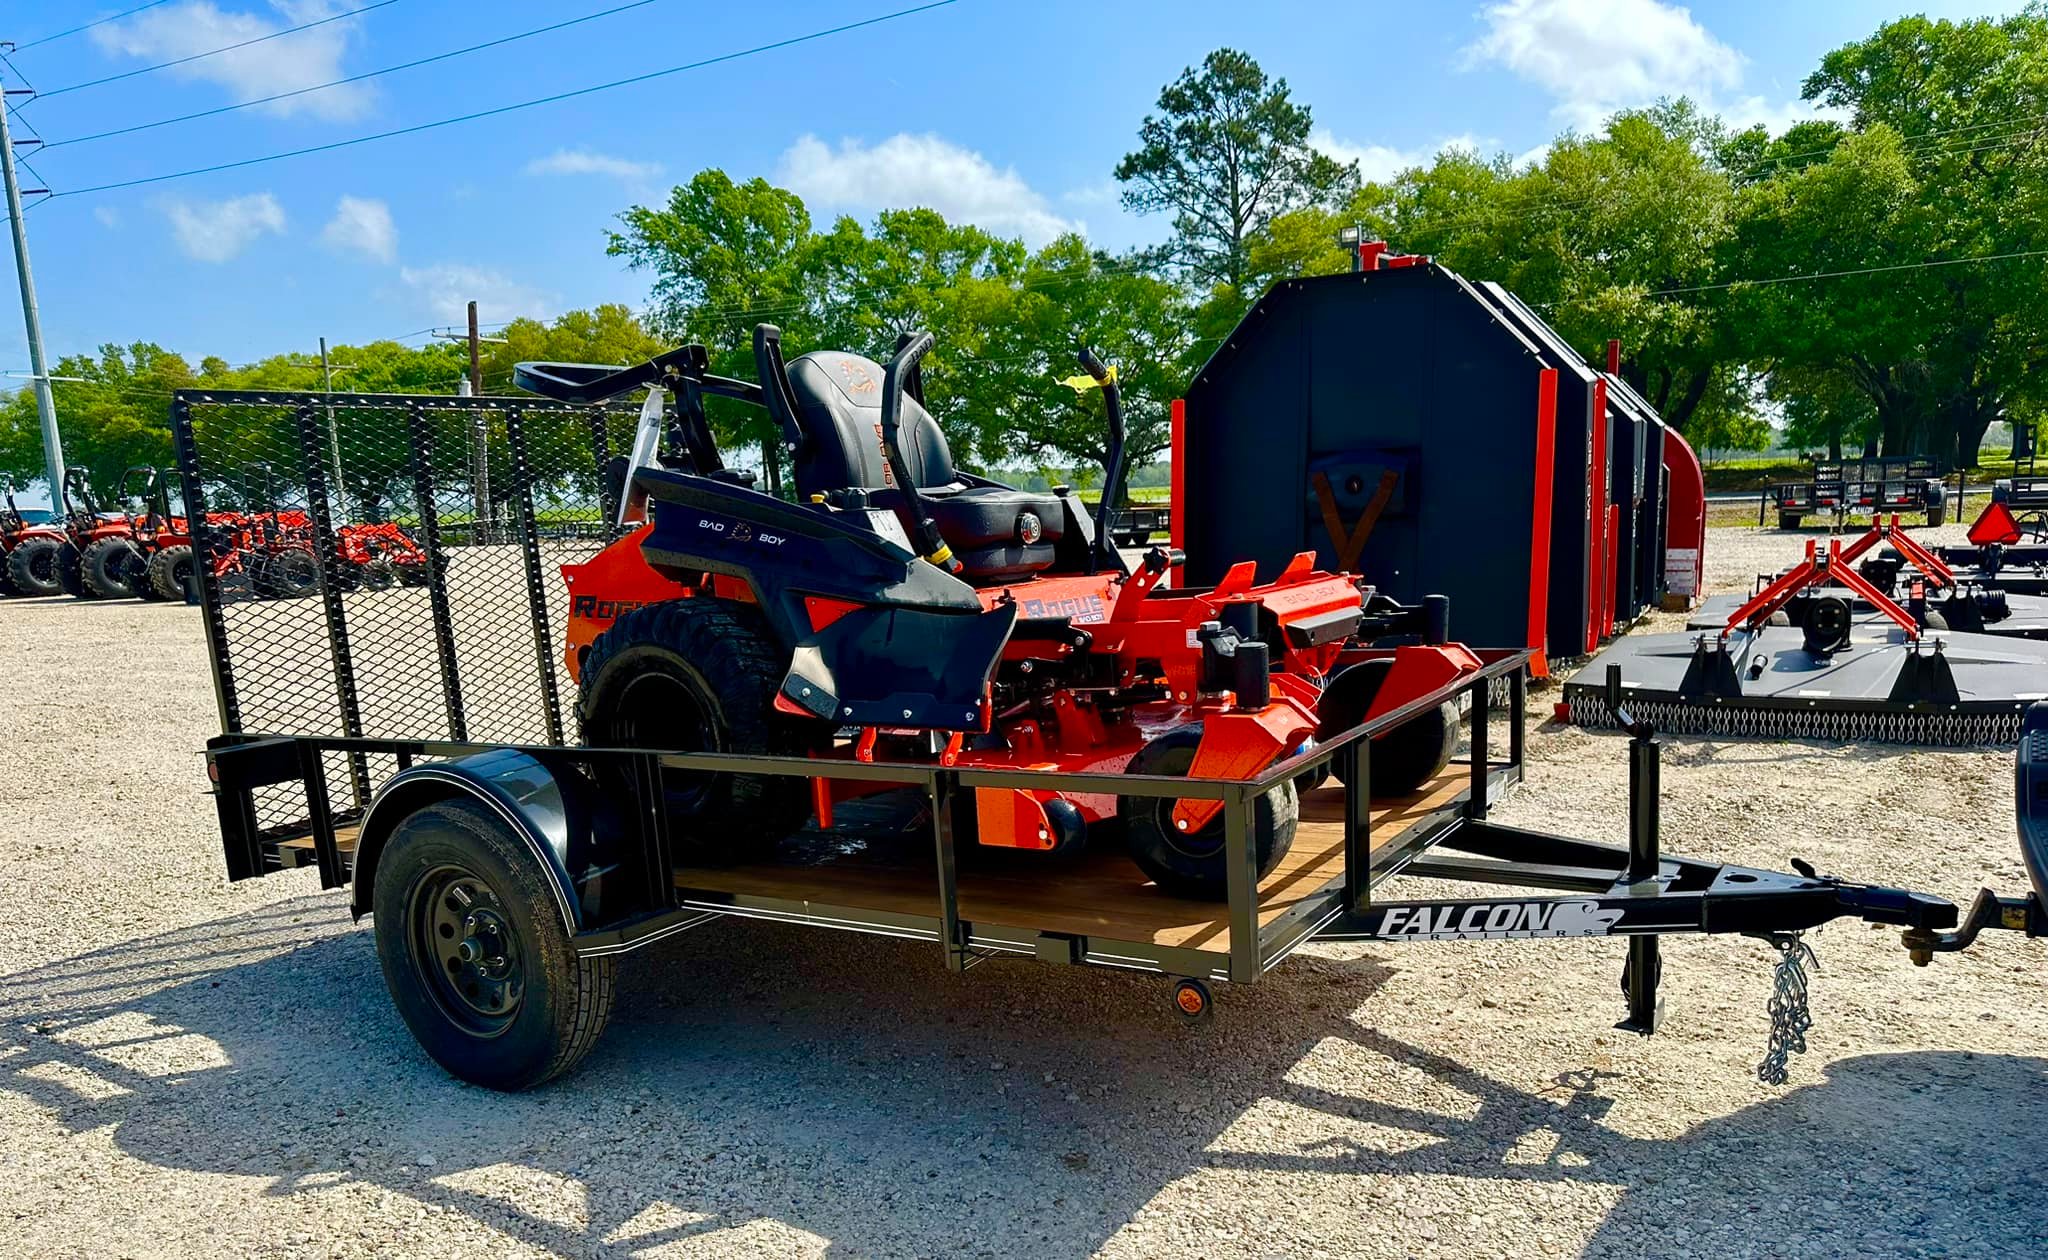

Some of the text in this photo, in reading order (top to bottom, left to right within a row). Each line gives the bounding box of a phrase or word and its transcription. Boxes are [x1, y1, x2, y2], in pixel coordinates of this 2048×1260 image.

[698, 519, 786, 546] BAD BOY
[1023, 594, 1104, 618] ROGUE
[1378, 903, 1553, 934] FALCON
[1407, 929, 1593, 941] TRAILERS
